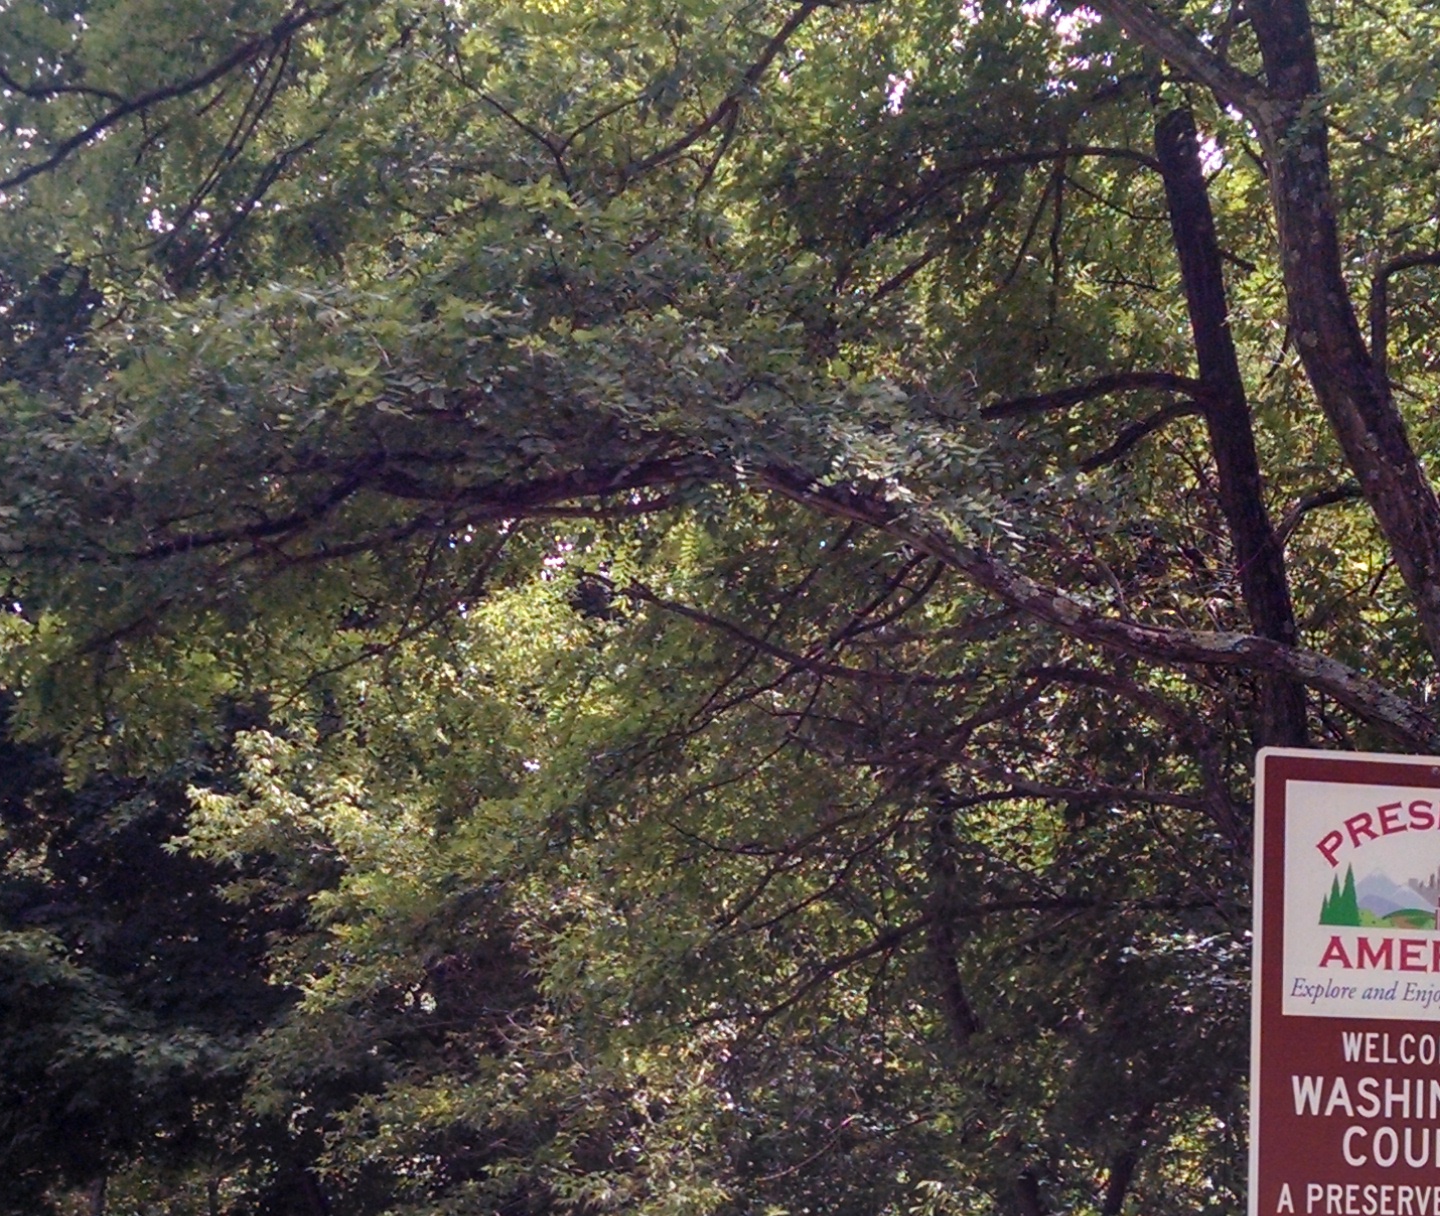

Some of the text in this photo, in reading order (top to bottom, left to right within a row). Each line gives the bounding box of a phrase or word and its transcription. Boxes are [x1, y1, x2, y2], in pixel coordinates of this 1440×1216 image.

[1290, 978, 1357, 1008] Explore
[1362, 982, 1399, 1001] and
[1277, 1183, 1295, 1214] A
